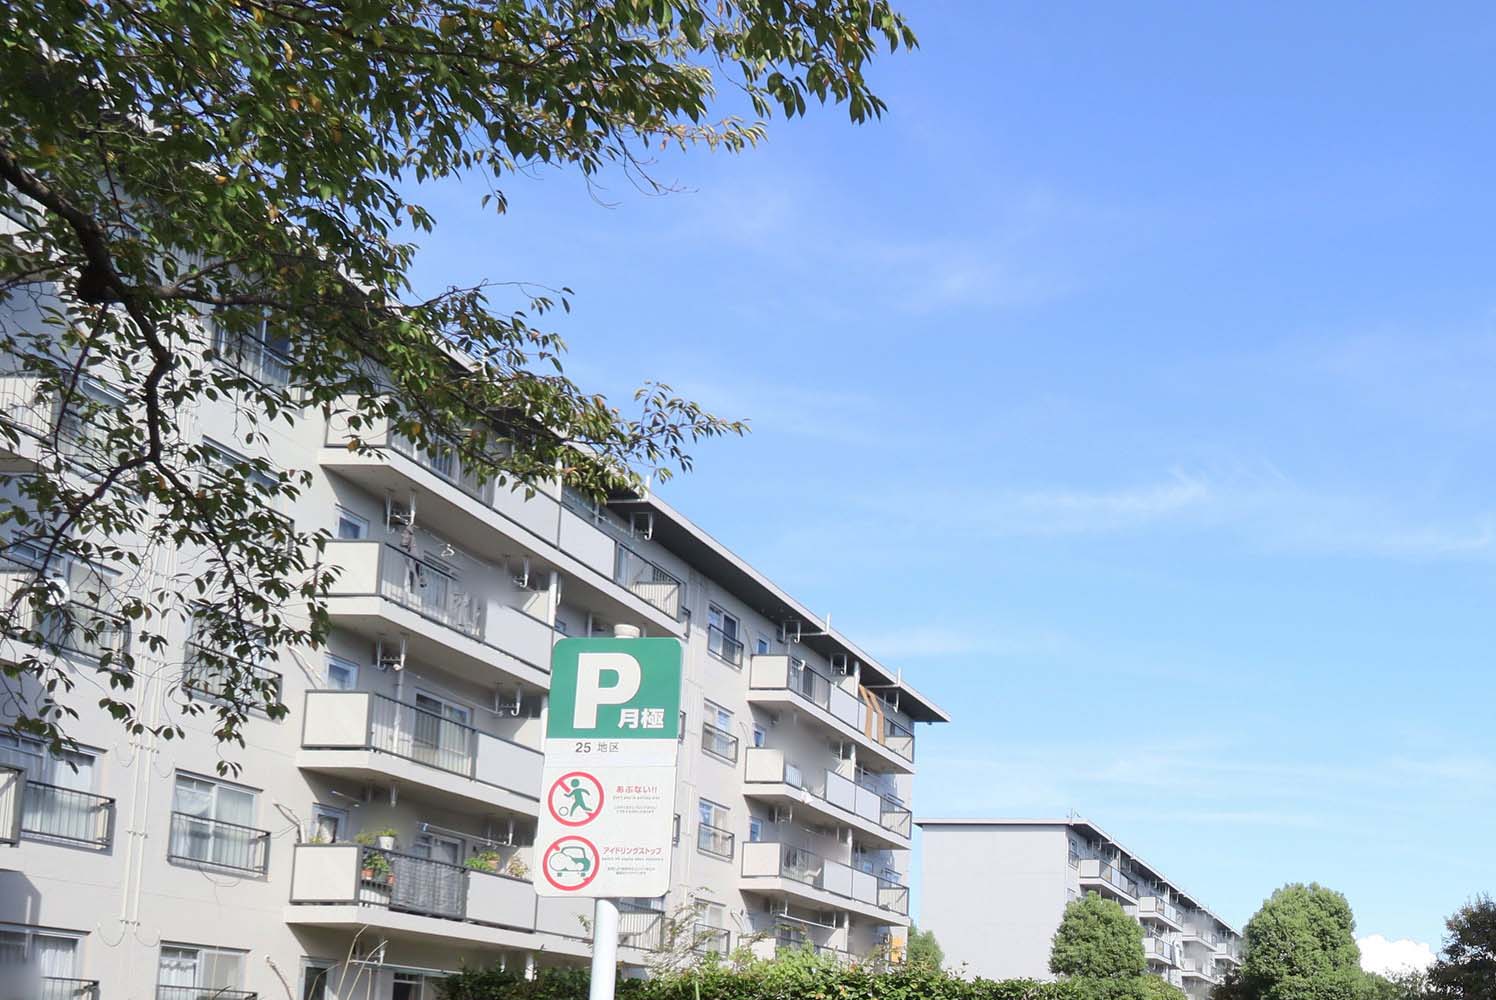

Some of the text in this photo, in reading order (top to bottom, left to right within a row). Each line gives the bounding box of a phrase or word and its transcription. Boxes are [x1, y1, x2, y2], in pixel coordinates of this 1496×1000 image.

[573, 653, 641, 728] P
[618, 708, 665, 729] 月極
[575, 742, 619, 753] 25 地区
[603, 847, 663, 855] アイドリングストップ
